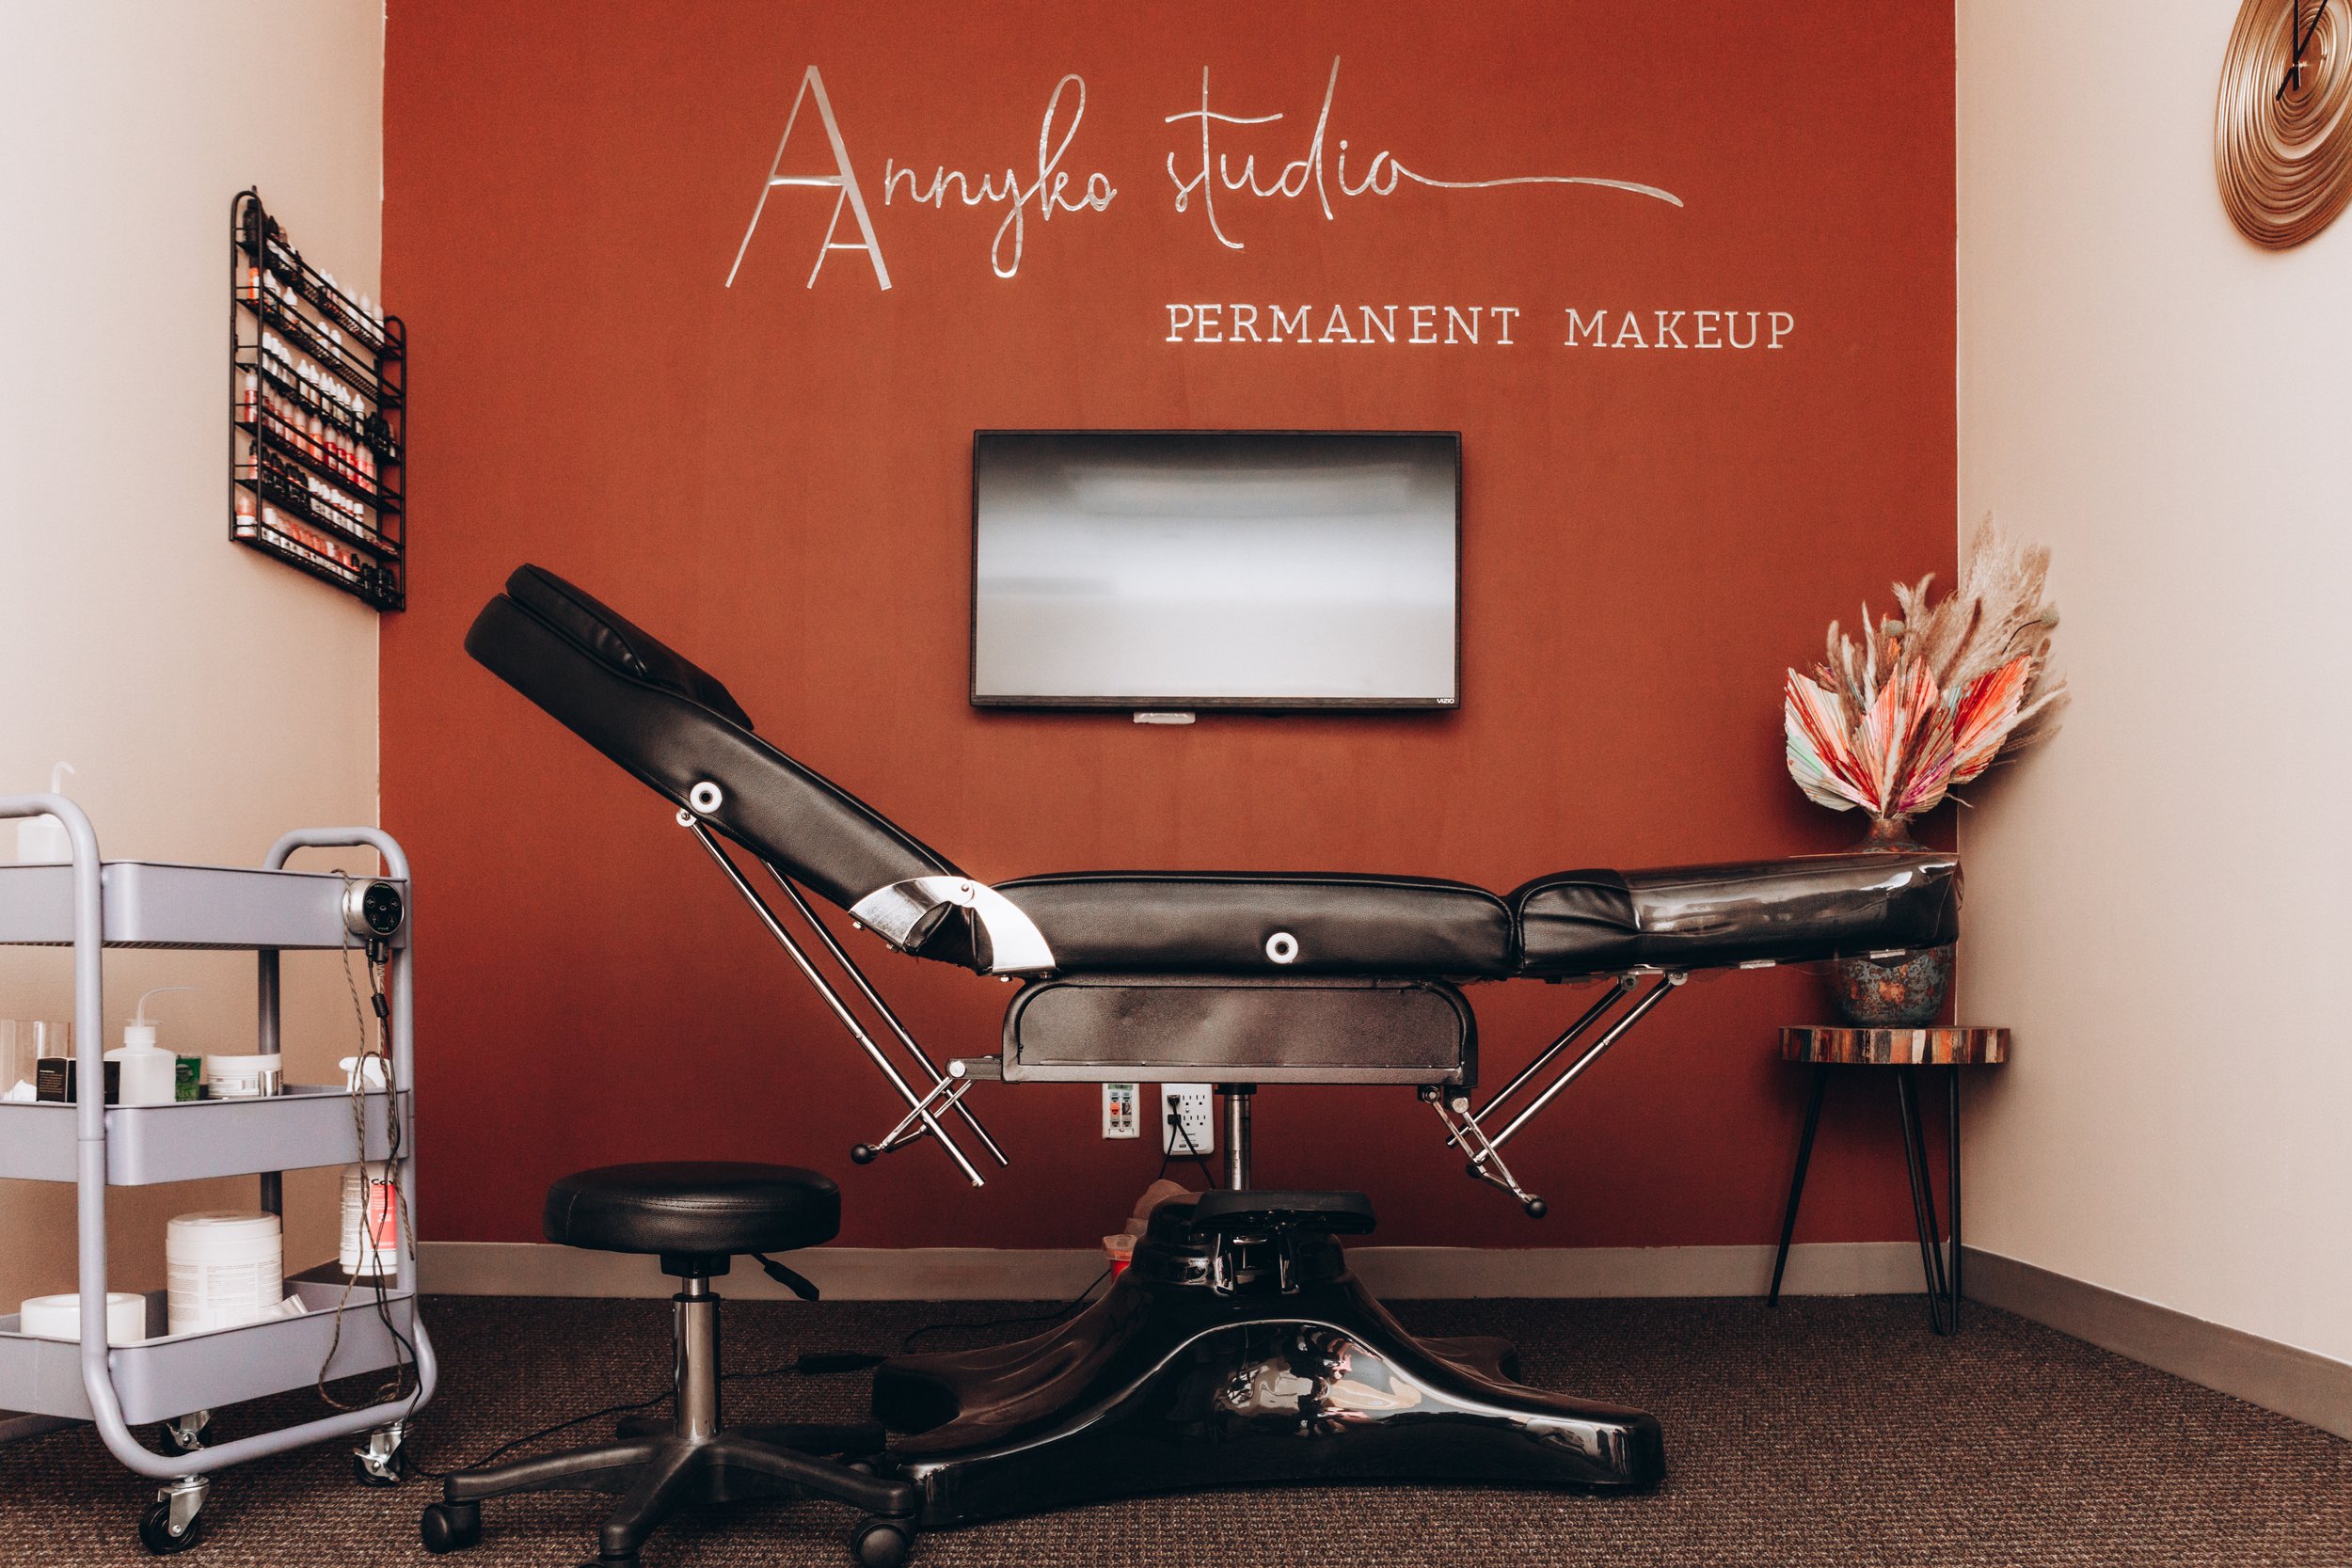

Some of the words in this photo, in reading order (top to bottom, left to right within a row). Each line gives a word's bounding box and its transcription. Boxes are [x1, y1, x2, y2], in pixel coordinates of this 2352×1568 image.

[725, 65, 1118, 291] Annyko
[1165, 55, 1684, 249] studio
[1166, 304, 1520, 345] PERMANENT
[1564, 309, 1794, 349] MAKEUP
